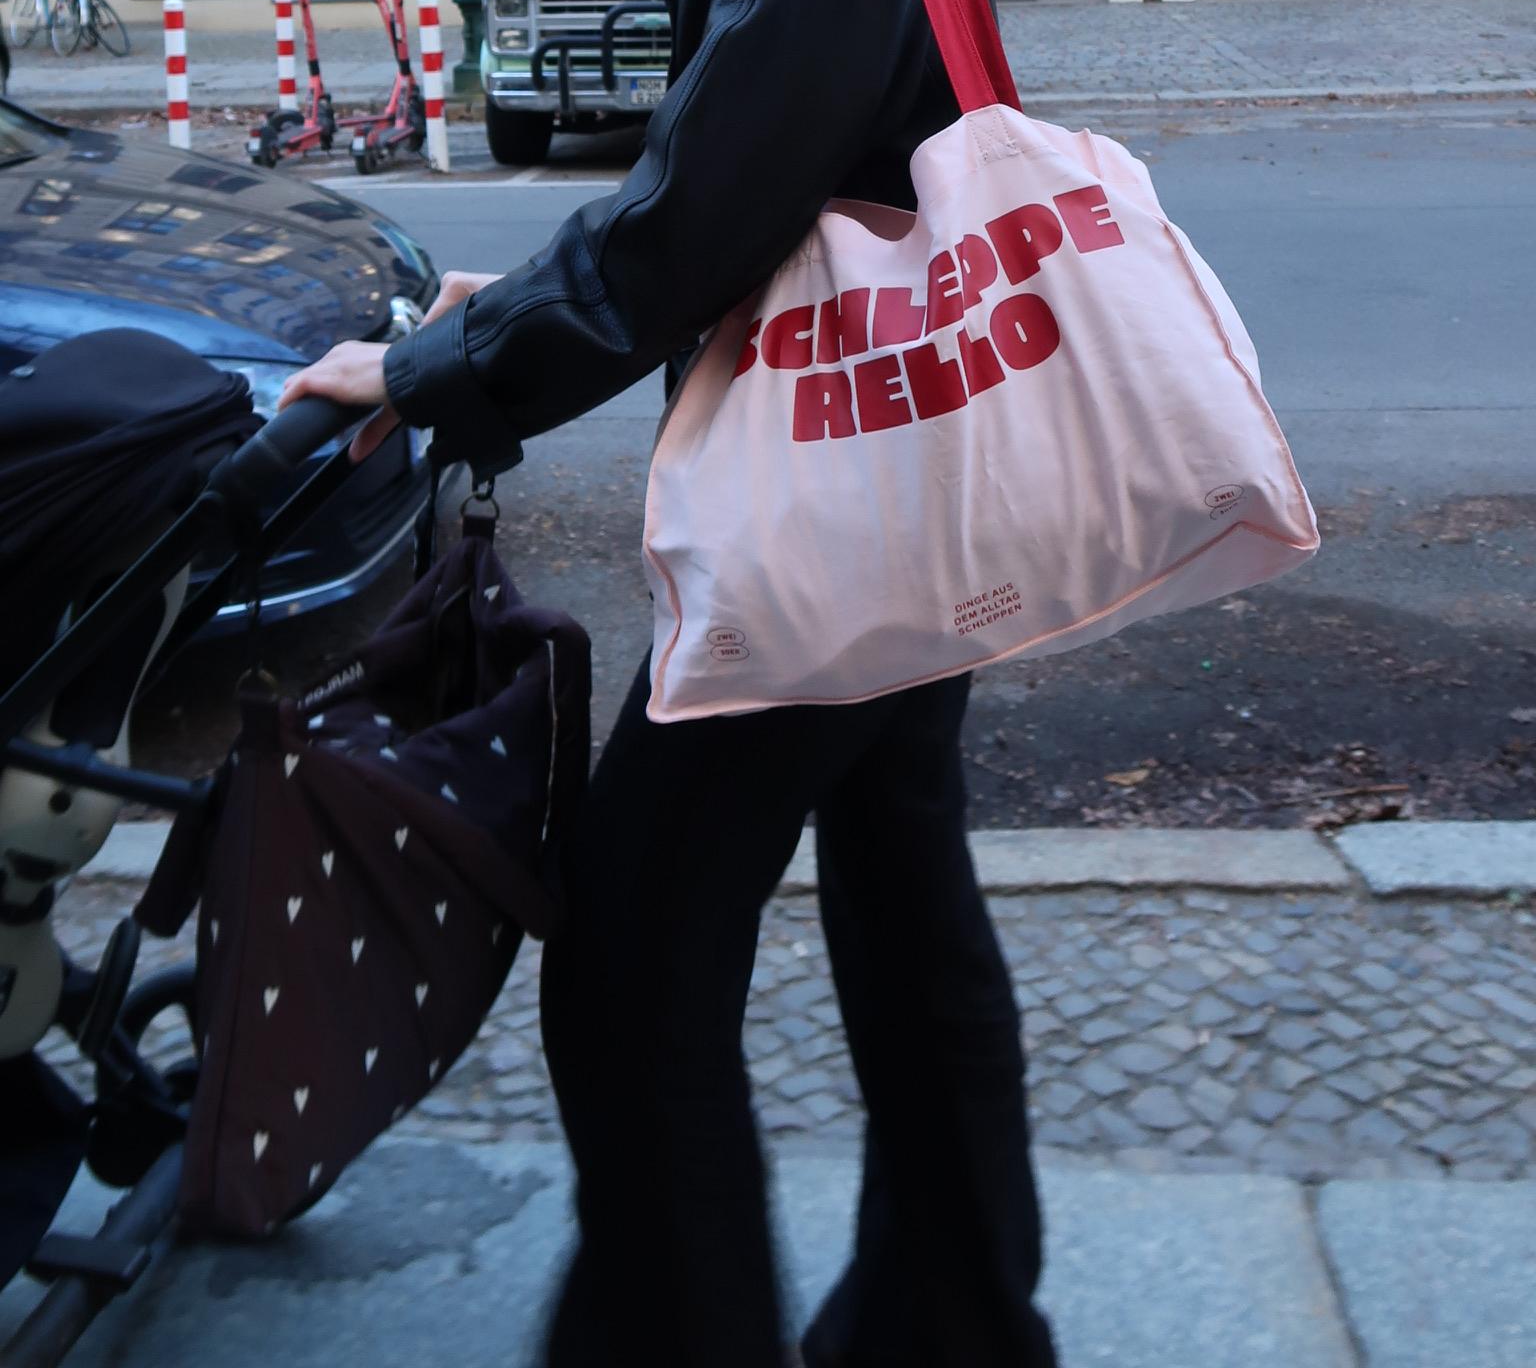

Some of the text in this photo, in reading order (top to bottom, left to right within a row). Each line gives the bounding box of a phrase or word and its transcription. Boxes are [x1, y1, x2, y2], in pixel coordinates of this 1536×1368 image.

[1214, 491, 1235, 502] ZWEI
[954, 592, 1020, 626] DEM ALLTAG
[955, 582, 1014, 613] DINGE AUS
[958, 603, 1022, 636] SCHLEPPEN
